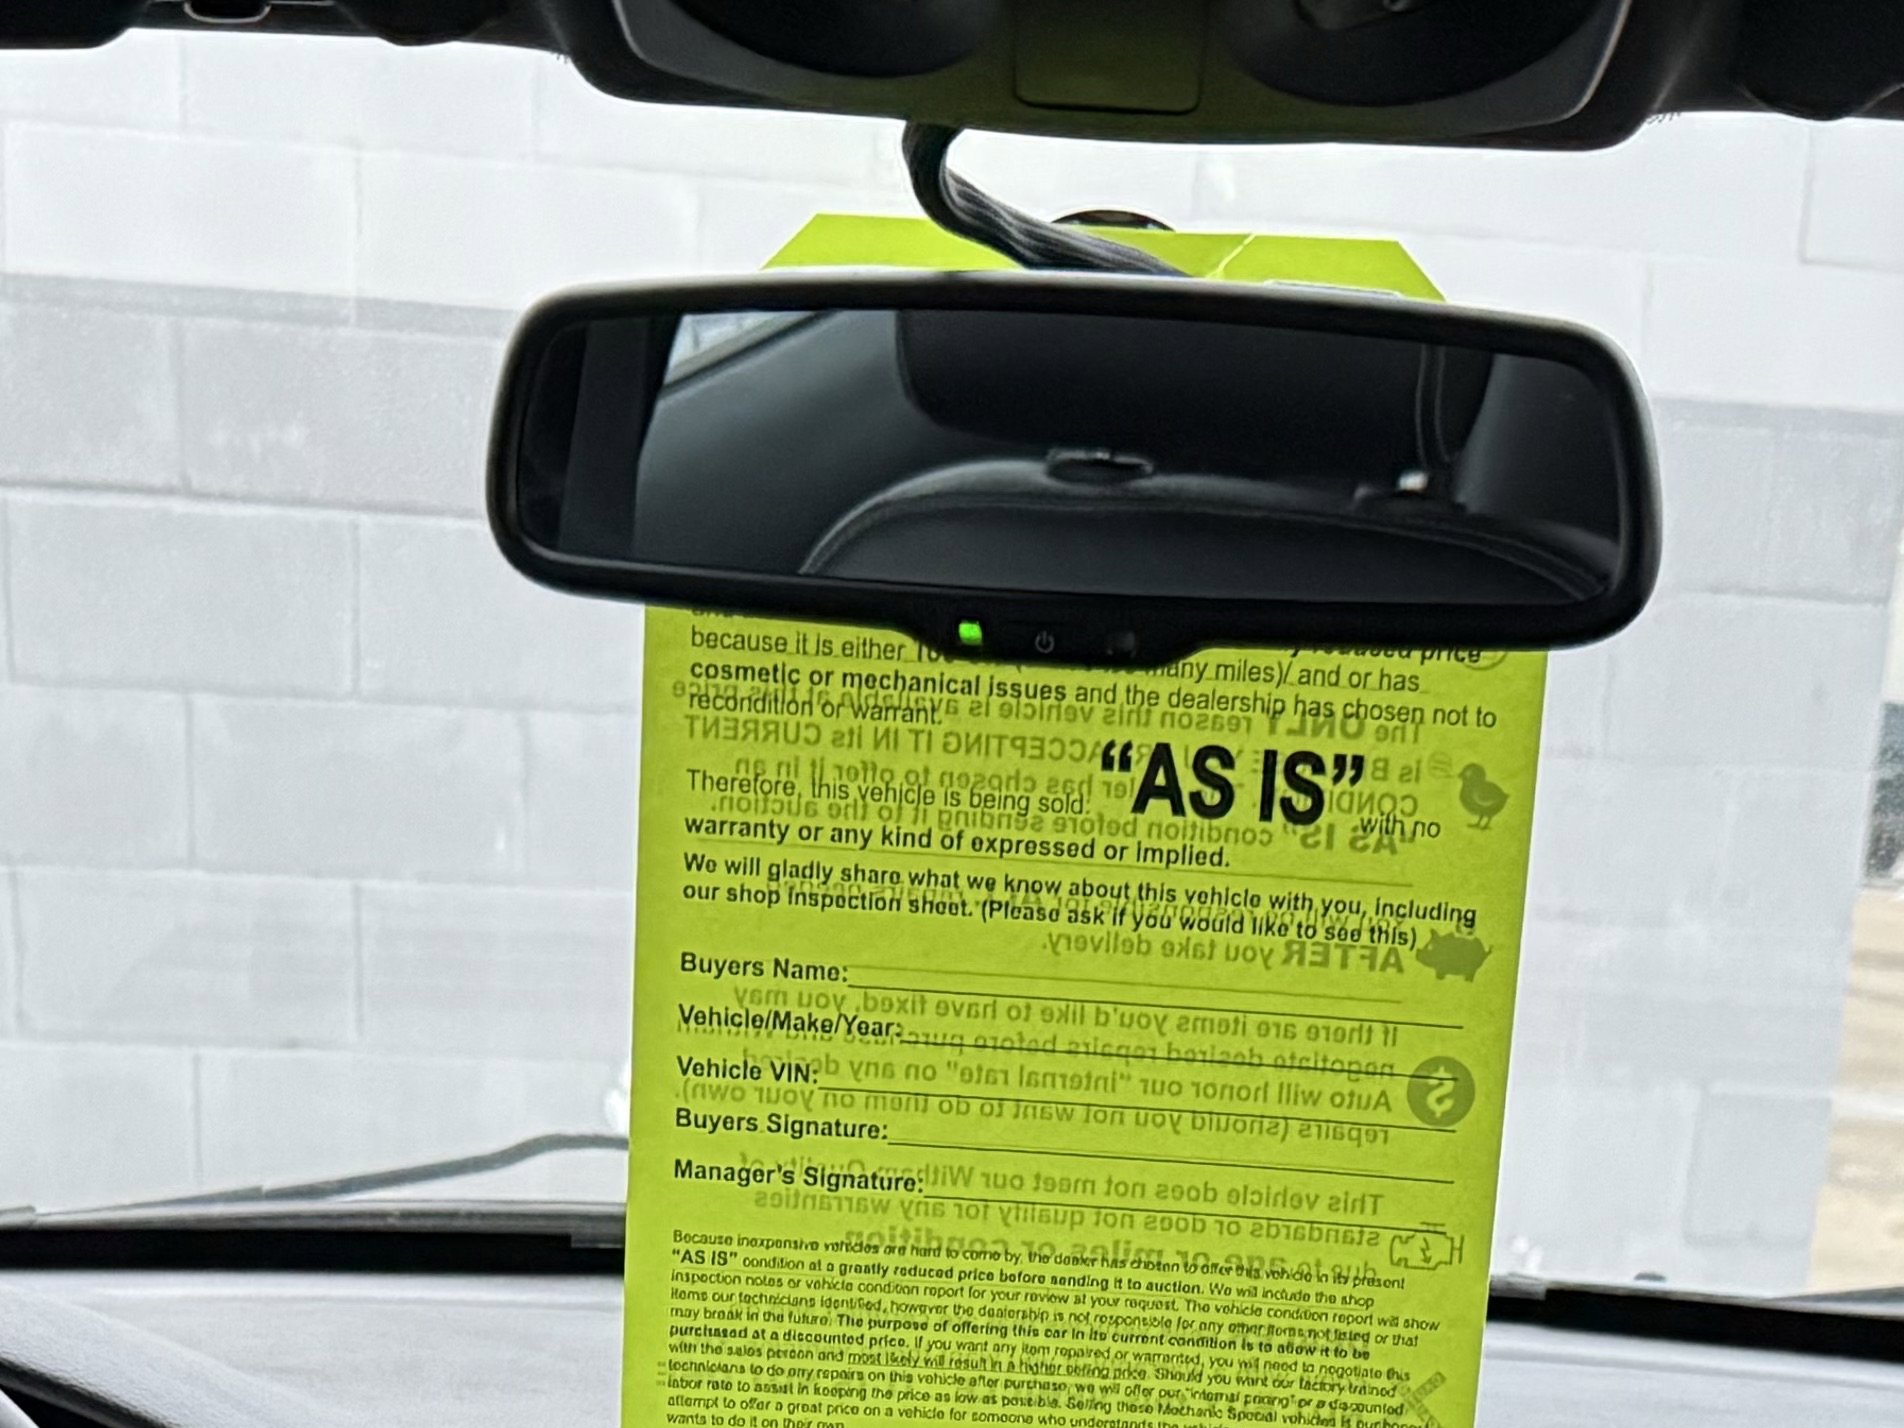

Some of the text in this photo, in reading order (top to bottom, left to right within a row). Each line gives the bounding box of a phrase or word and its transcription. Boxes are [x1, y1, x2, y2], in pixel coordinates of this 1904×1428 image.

[692, 625, 786, 654] because
[796, 631, 810, 655] it
[815, 633, 832, 655] is
[841, 633, 906, 661] either
[1298, 664, 1340, 688] and
[1349, 670, 1372, 689] or
[1379, 668, 1420, 693] has
[691, 661, 800, 684] cosmetic
[809, 670, 834, 687] or
[841, 667, 981, 697] mechanical
[989, 674, 1066, 702] issues
[1075, 685, 1117, 705] and
[1126, 684, 1159, 707] the
[1168, 687, 1285, 716] dealership
[1294, 694, 1335, 718] has
[1343, 697, 1424, 723] chosen
[1433, 702, 1469, 726] not
[1476, 705, 1497, 729] to
[687, 769, 1030, 817] Therefore, this vehicle is being
[685, 817, 1230, 869] warranty or any kind of expressed or implied.
[684, 853, 1476, 929] We will gladly share what we know about this vehicle with you, including
[681, 952, 849, 983] Buyers Name:
[679, 1004, 901, 1039] Vehicle/Make/Year:
[677, 1056, 819, 1084] Vehicle VIN:
[675, 1107, 888, 1142] Buyers Signature:
[674, 1159, 923, 1196] Manager's Signature:
